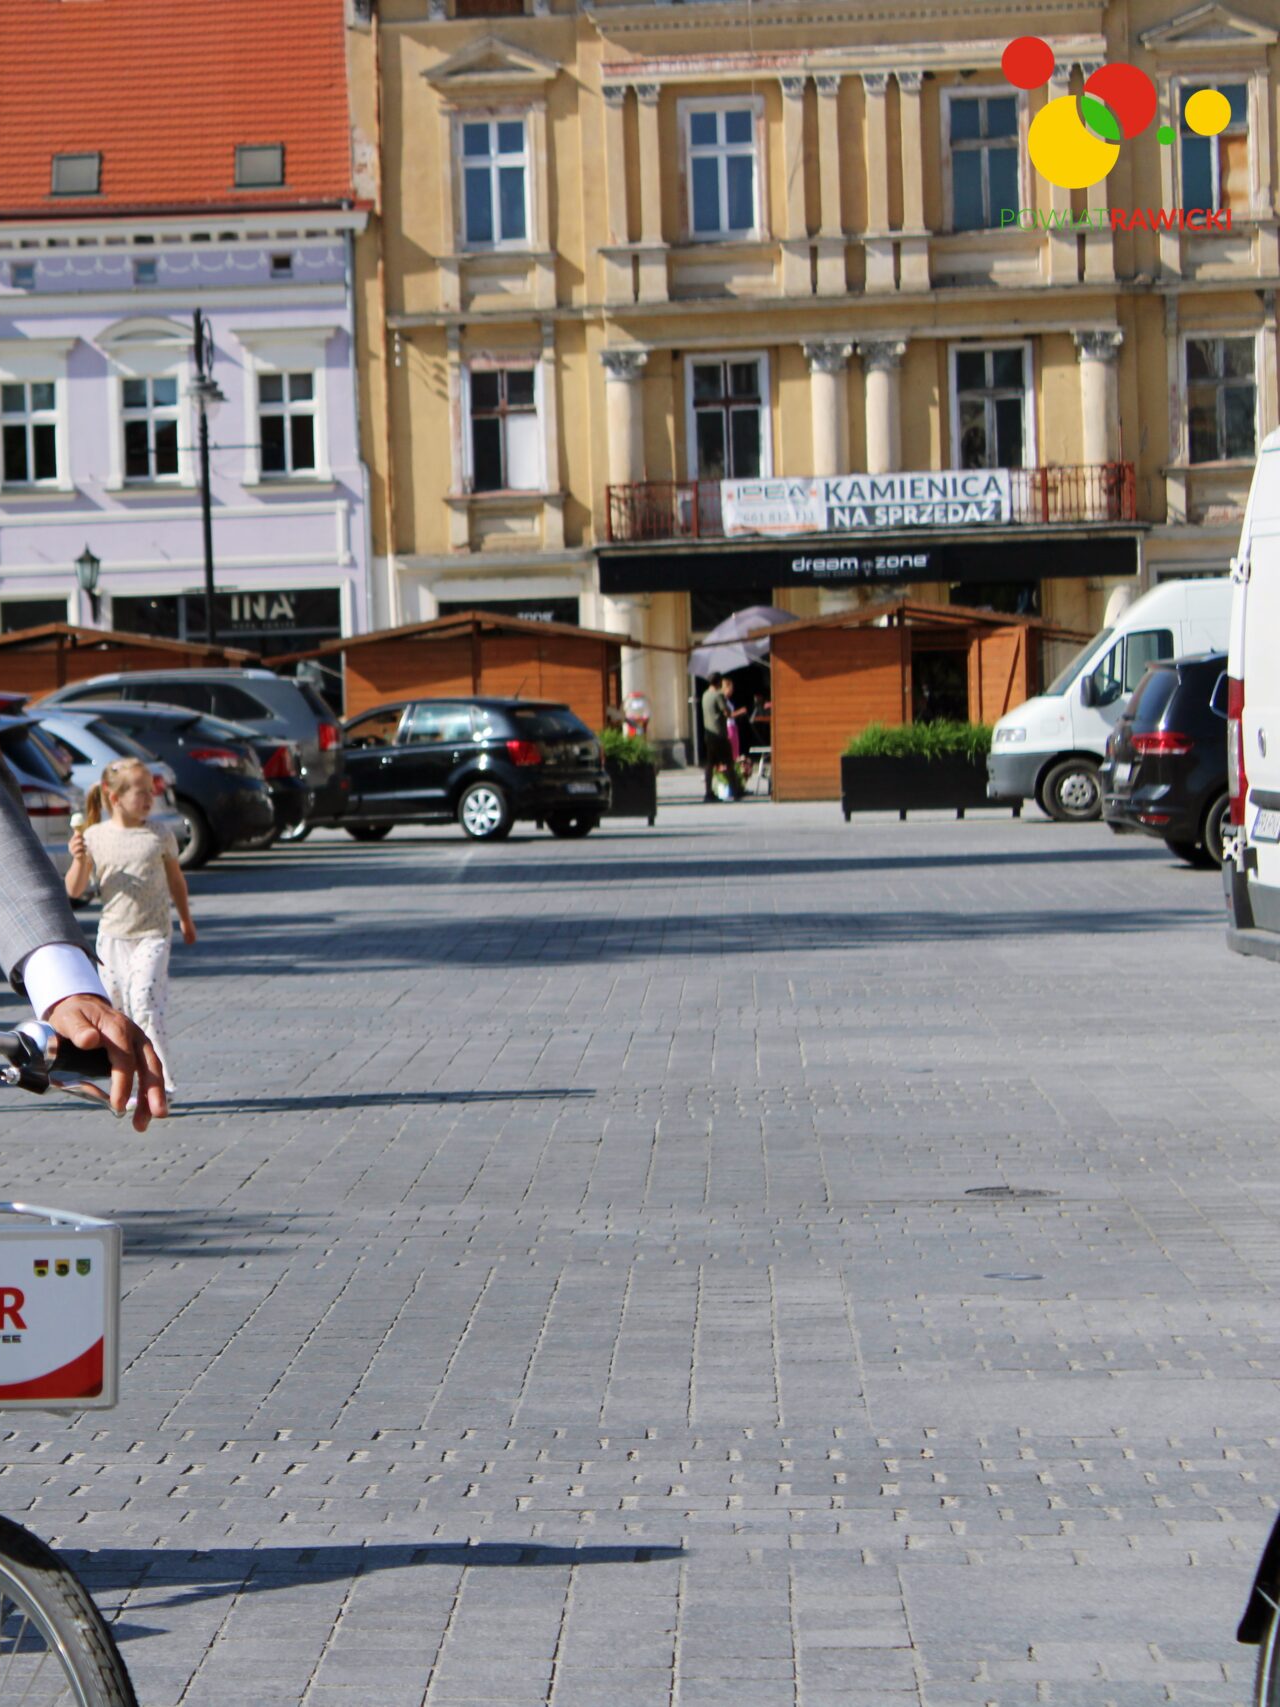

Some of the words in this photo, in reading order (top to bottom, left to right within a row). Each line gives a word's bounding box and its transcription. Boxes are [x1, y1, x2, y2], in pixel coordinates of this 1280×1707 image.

[824, 476, 1003, 502] KAMIENICA
[833, 508, 869, 528] NA
[874, 500, 995, 526] SPRZEDAŻ
[792, 556, 859, 572] dream
[875, 554, 927, 569] zone
[231, 593, 294, 621] INA
